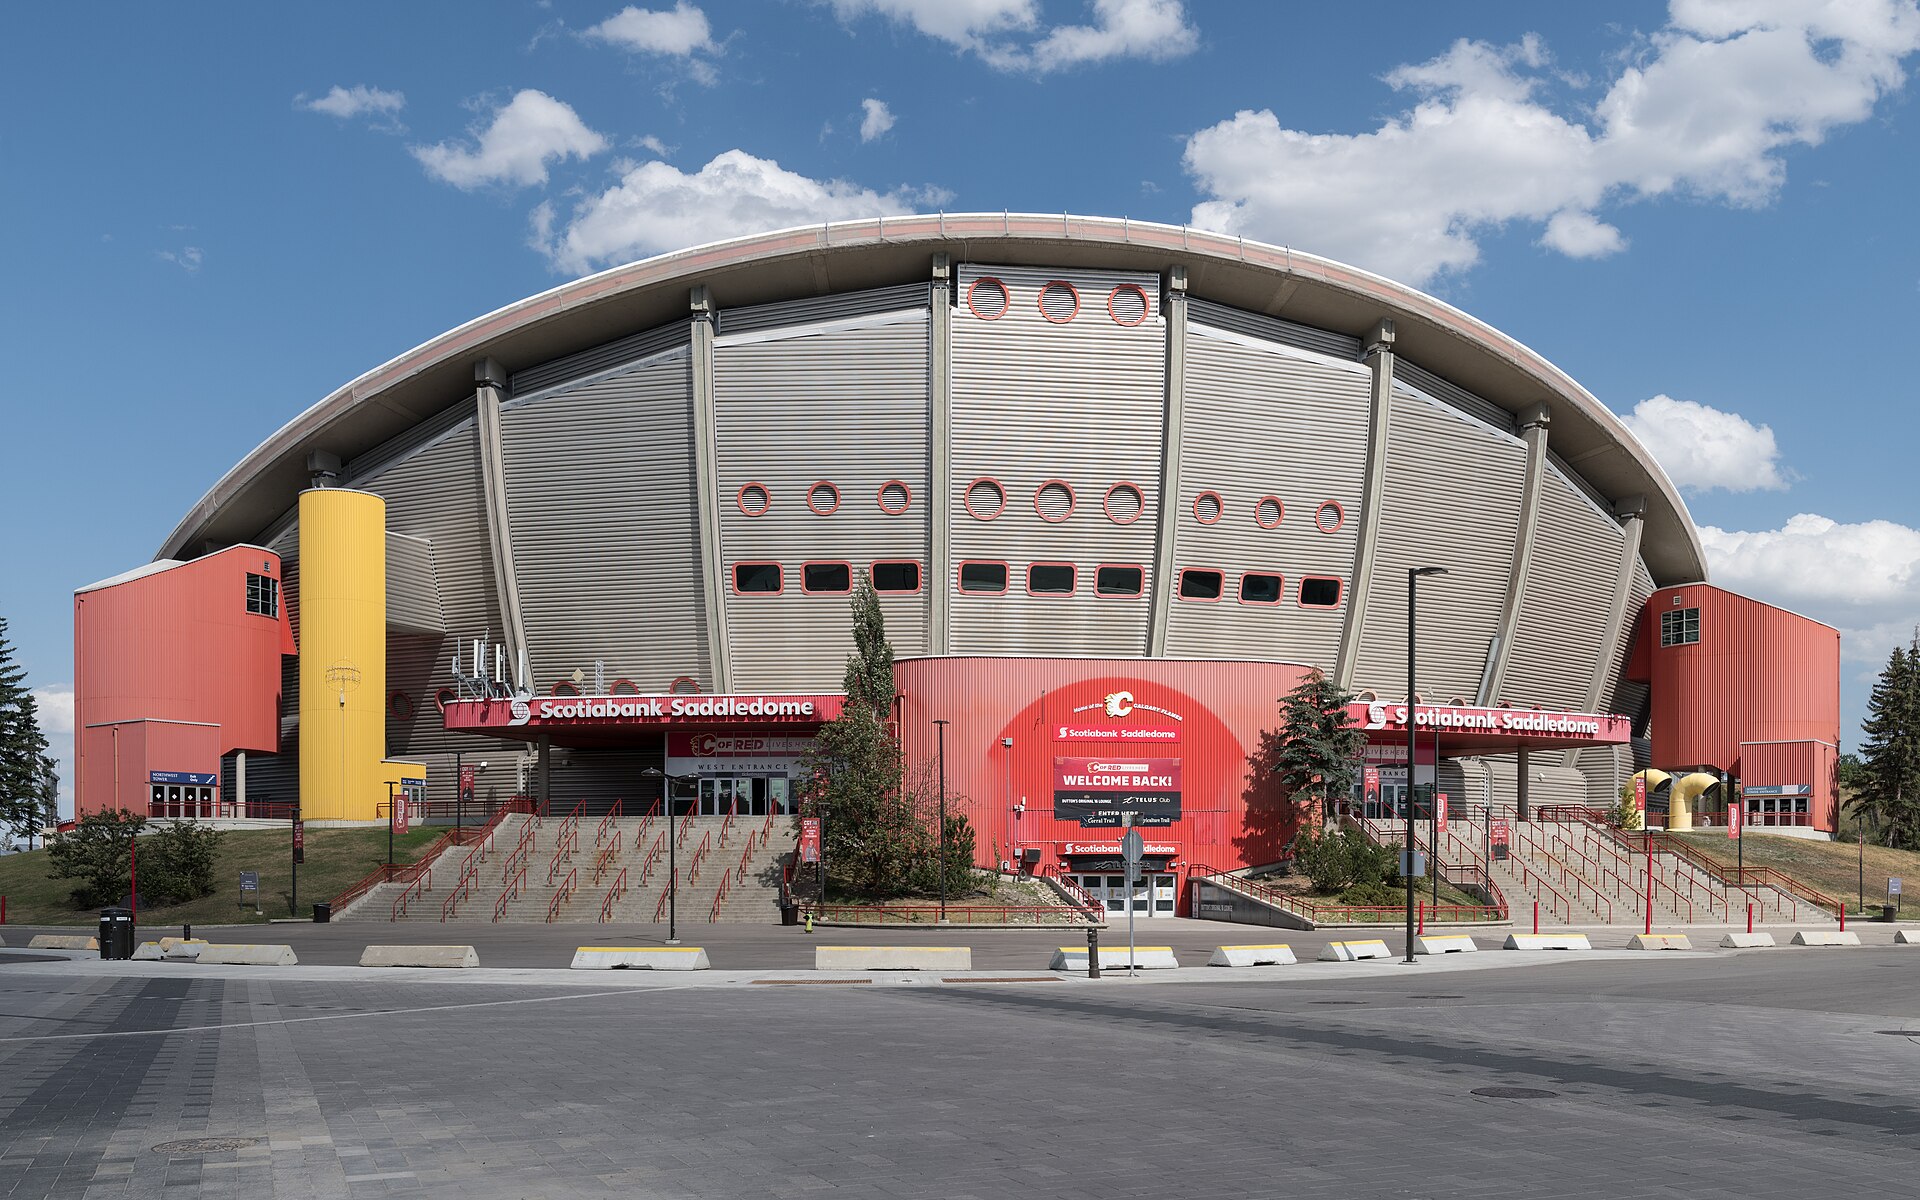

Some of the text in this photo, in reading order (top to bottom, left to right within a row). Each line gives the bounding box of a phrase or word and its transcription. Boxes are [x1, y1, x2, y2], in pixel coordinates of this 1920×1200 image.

[540, 697, 813, 718] Scotiabank Saddledome
[1133, 703, 1160, 713] CALGARY
[1160, 708, 1183, 722] FLAMES
[1395, 707, 1600, 734] Sotiabank Saddledome
[1069, 729, 1176, 738] Scotiabank Saddledome
[718, 741, 732, 749] OF
[735, 740, 764, 750] RED
[1063, 775, 1172, 787] WELCOME BACK!
[1087, 816, 1103, 824] Corral
